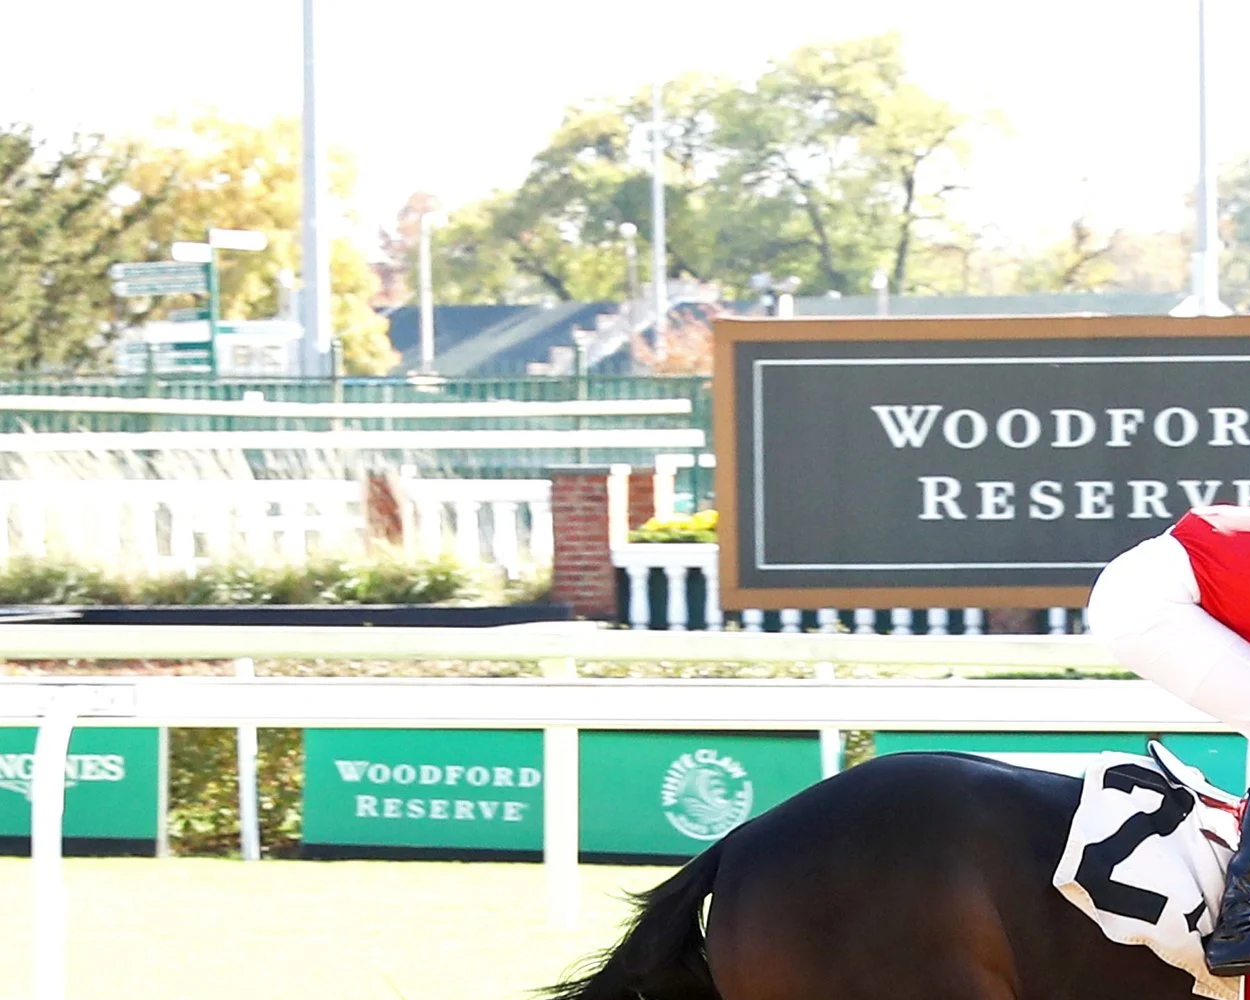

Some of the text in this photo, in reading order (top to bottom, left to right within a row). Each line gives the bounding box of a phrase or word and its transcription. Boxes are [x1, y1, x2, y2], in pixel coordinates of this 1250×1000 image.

[334, 760, 542, 788] WOODFORD
[355, 794, 524, 822] RESERVE
[1075, 764, 1193, 925] 2
